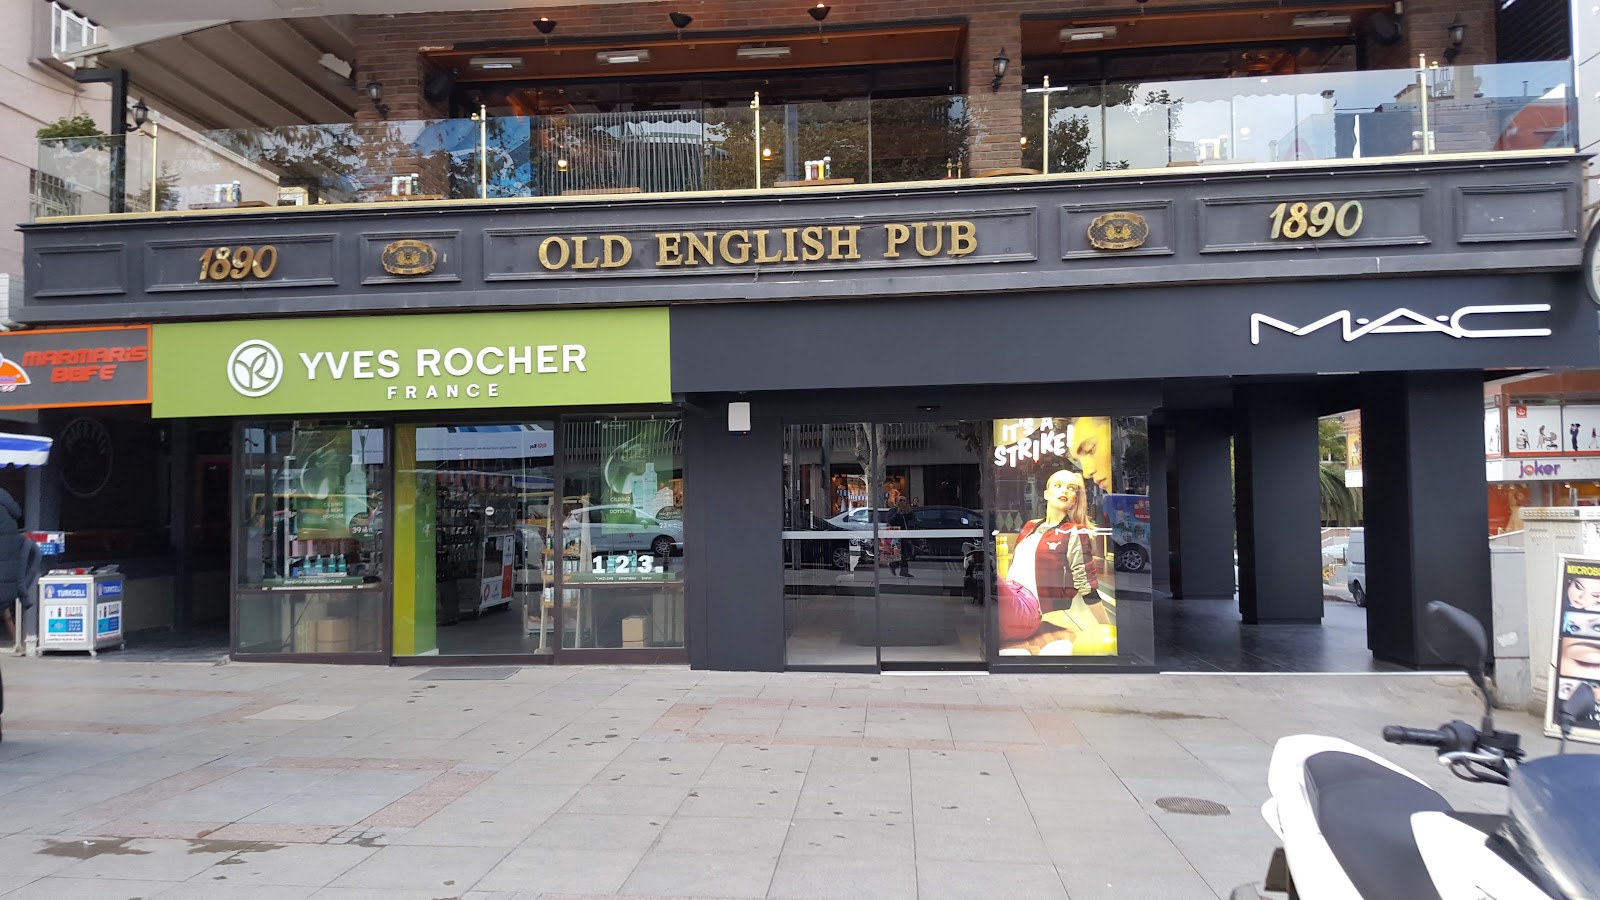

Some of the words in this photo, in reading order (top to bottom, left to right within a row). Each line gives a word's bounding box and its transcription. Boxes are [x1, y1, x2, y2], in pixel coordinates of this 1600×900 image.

[1268, 200, 1364, 240] 1890
[538, 234, 633, 270] OLD
[655, 225, 861, 267] ENGLISH
[883, 221, 978, 259] PUB
[198, 244, 278, 281] 1890
[299, 349, 400, 381] YVES
[416, 344, 587, 378] ROCHER
[387, 383, 500, 400] FRANCE
[1002, 418, 1034, 442] IT'S
[1040, 417, 1054, 431] A
[994, 424, 1074, 468] STRIKE!
[1518, 460, 1560, 478] joker
[592, 556, 606, 574] 1
[616, 555, 630, 574] 2
[57, 588, 86, 598] TURKCELL
